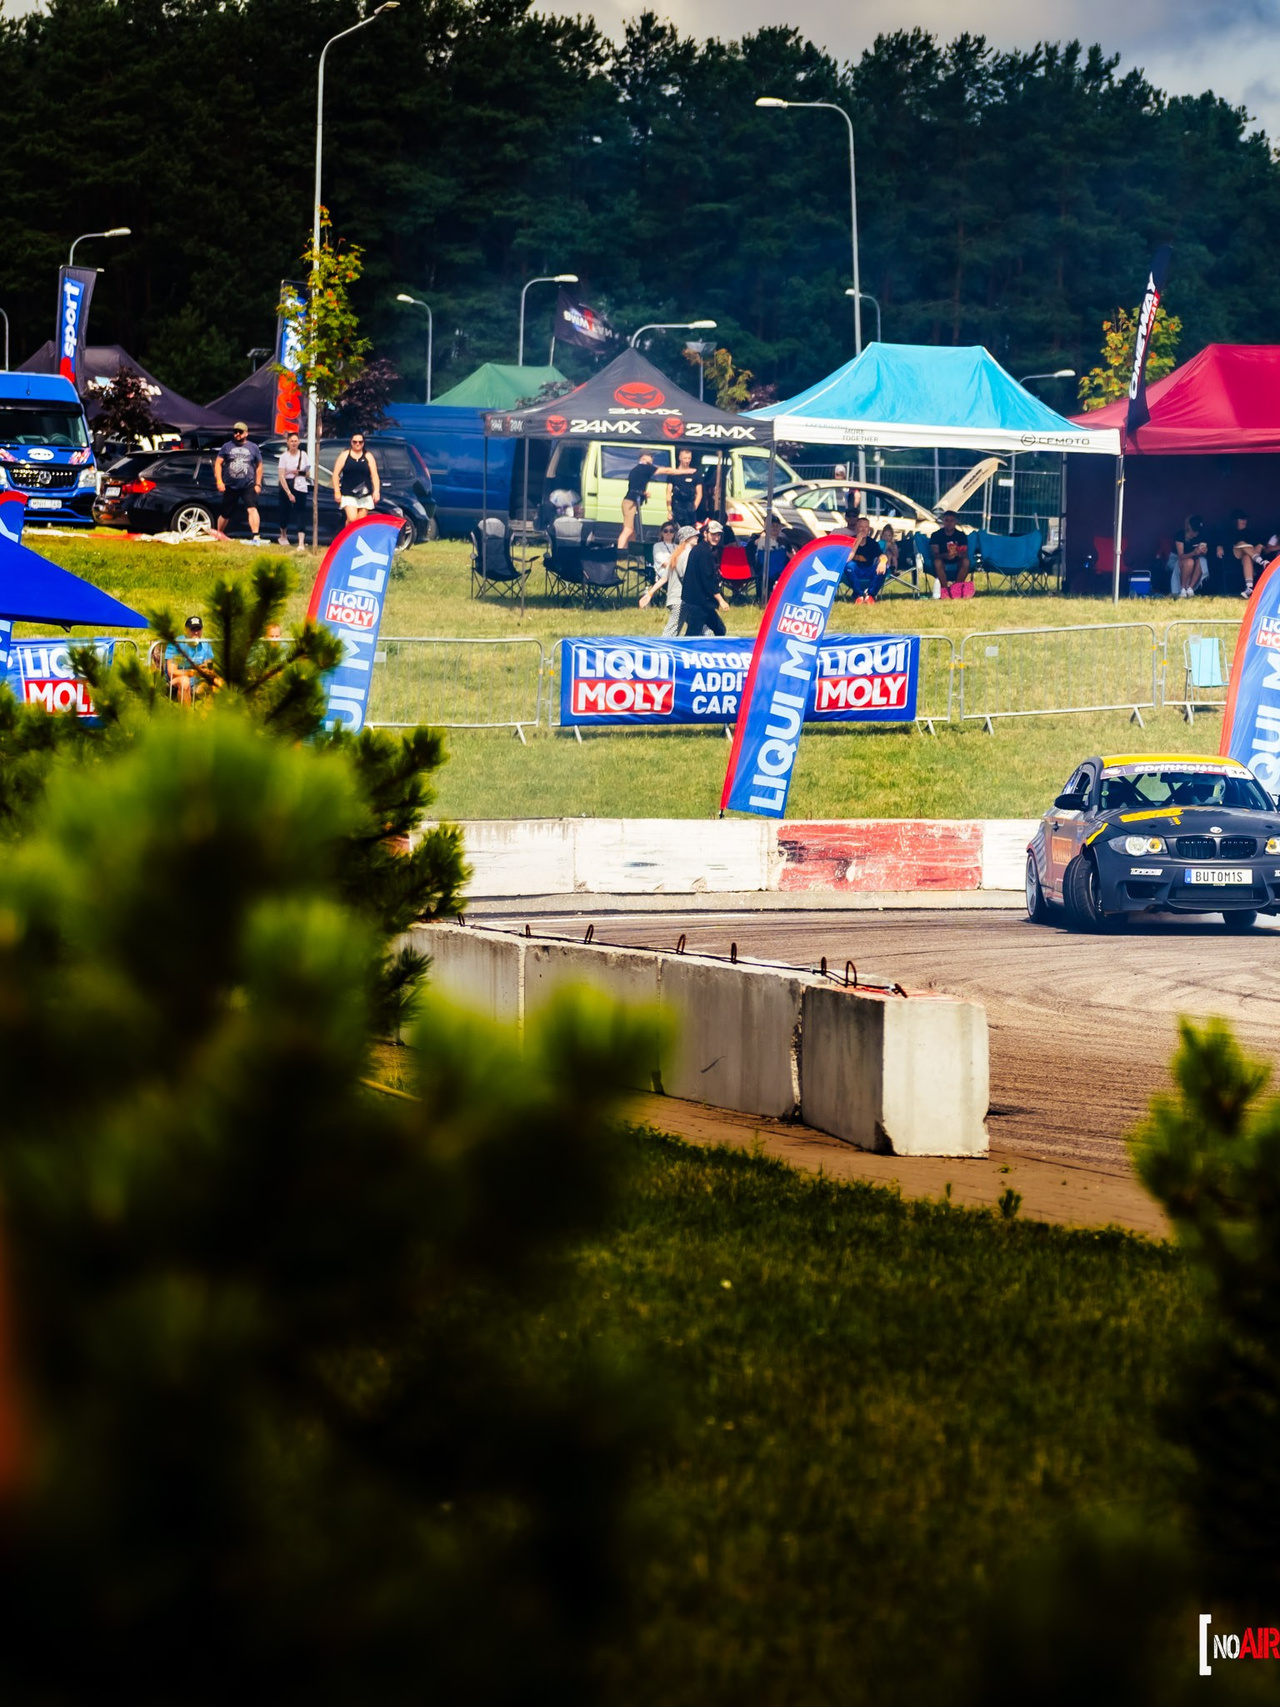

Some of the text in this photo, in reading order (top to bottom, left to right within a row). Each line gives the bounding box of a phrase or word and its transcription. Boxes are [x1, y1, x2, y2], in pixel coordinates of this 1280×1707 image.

[608, 407, 683, 416] 24MX
[569, 419, 642, 435] 24MX
[685, 423, 756, 441] 24MX
[331, 590, 374, 612] LIQUI
[328, 607, 374, 628] MOLY
[784, 604, 822, 625] LIQUI
[780, 617, 819, 640] MOLY
[578, 649, 669, 680] LIQUI
[821, 642, 906, 676] LIQUI
[28, 682, 95, 713] MOL
[578, 682, 673, 711] MOLY
[821, 676, 907, 708] MOLY
[692, 695, 738, 715] CAR
[749, 690, 806, 812] LIQUI
[1195, 871, 1243, 882] BUTOM1S
